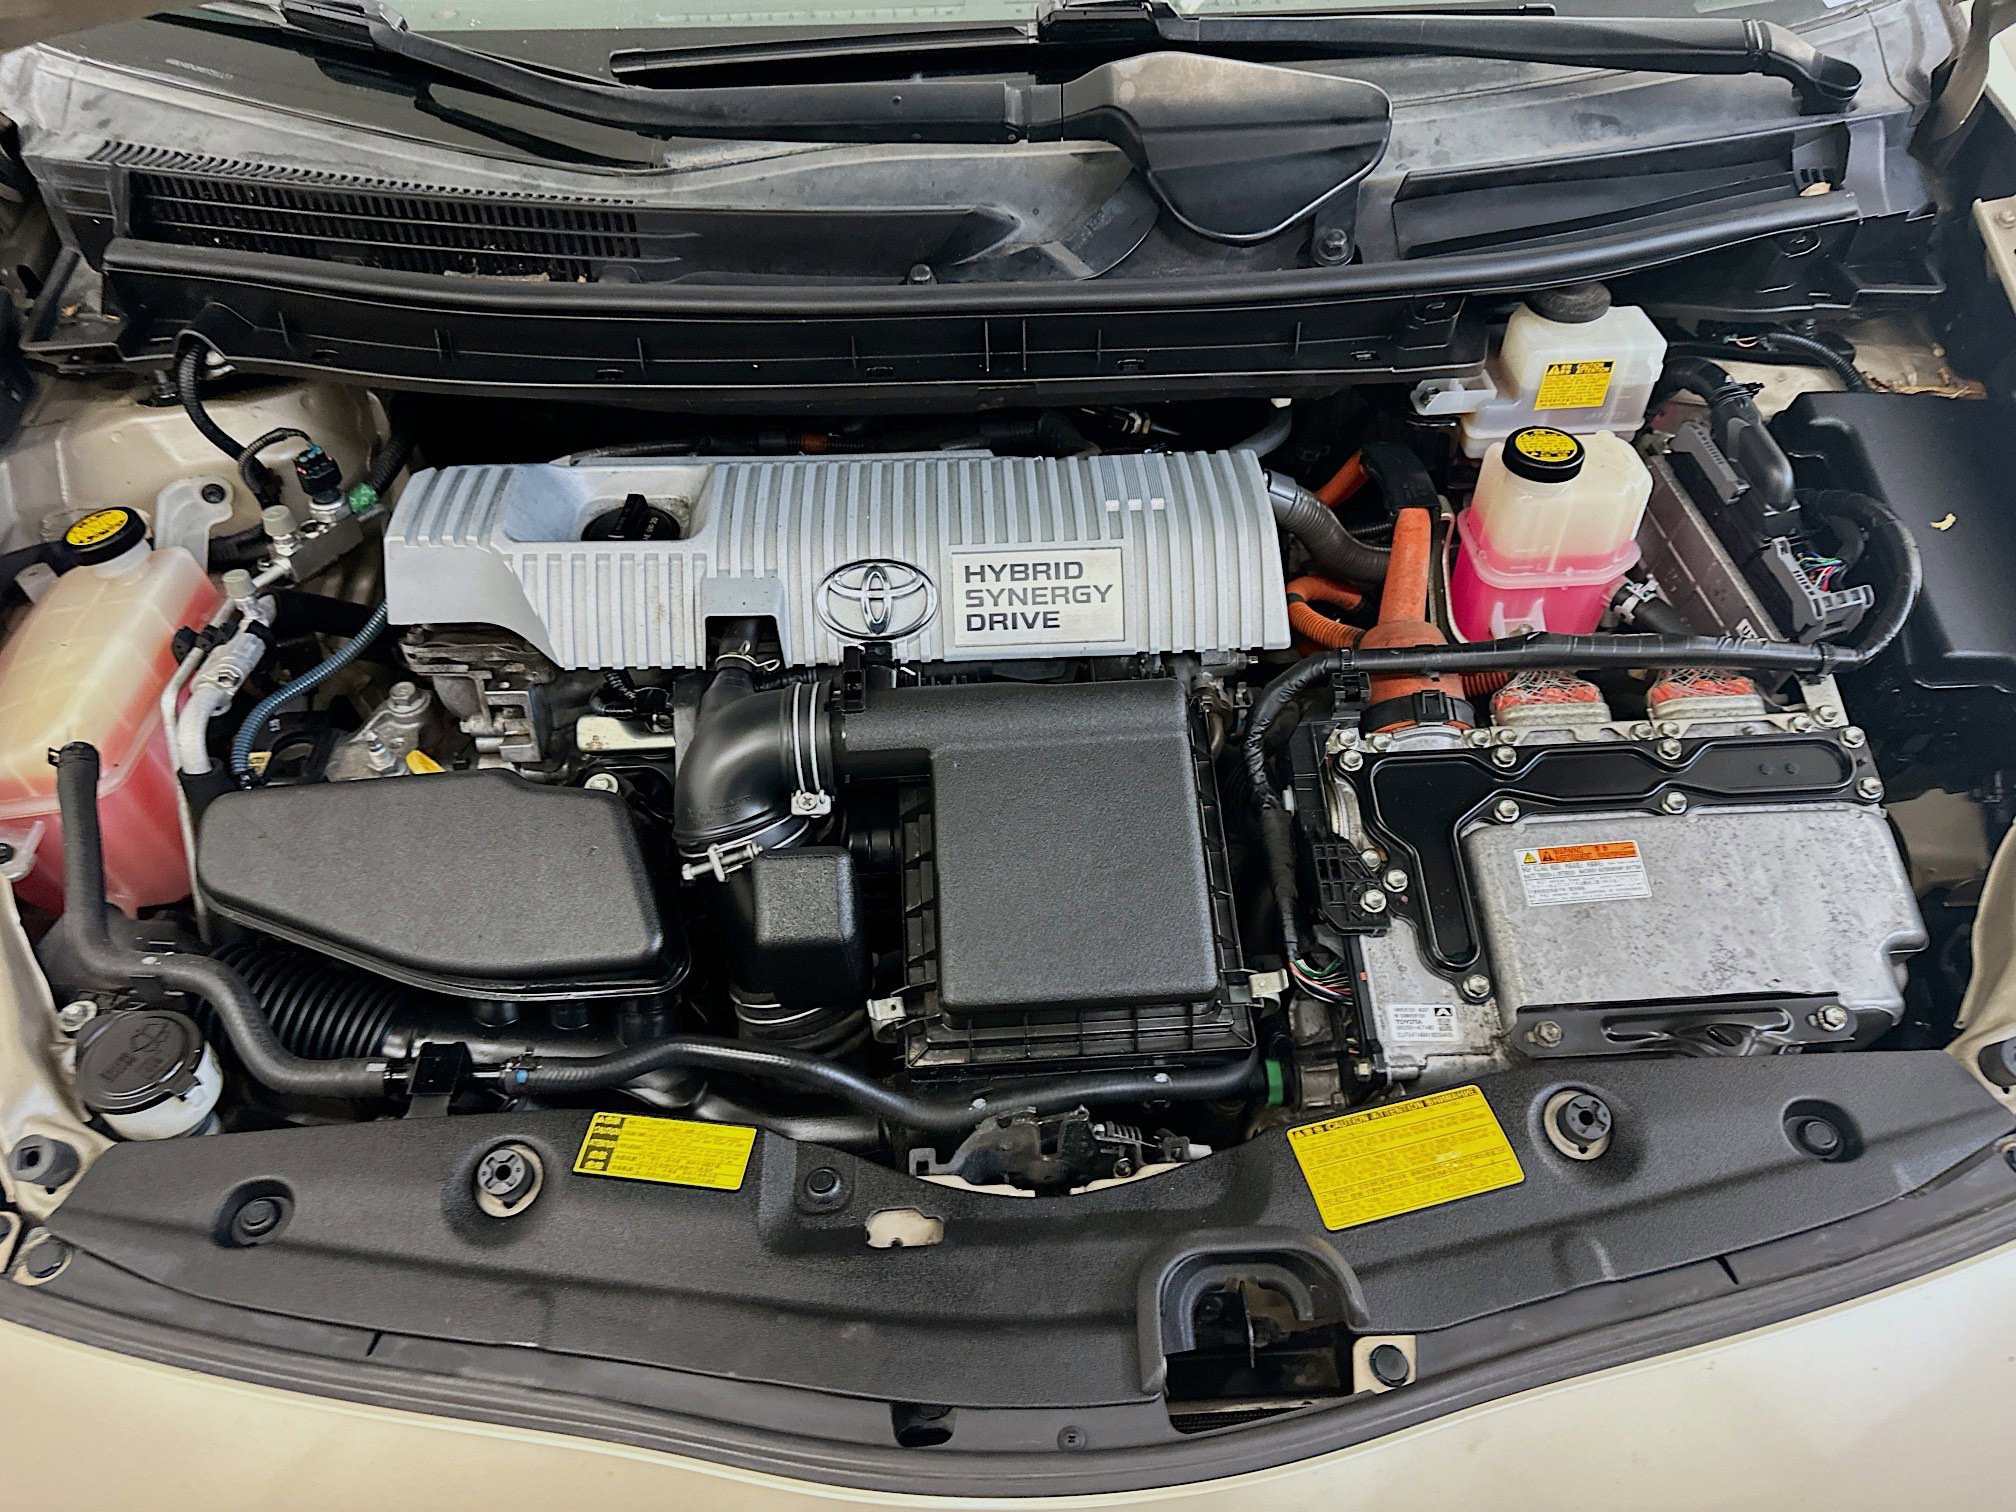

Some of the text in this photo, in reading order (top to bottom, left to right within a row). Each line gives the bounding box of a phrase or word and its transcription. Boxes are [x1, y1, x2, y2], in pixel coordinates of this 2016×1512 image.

[965, 561, 1084, 583] HYBRID
[965, 584, 1114, 608] SYNERGY
[966, 611, 1061, 631] DRIVE
[1326, 1113, 1369, 1131] CAUTION
[1370, 1100, 1424, 1119] ATTENTION
